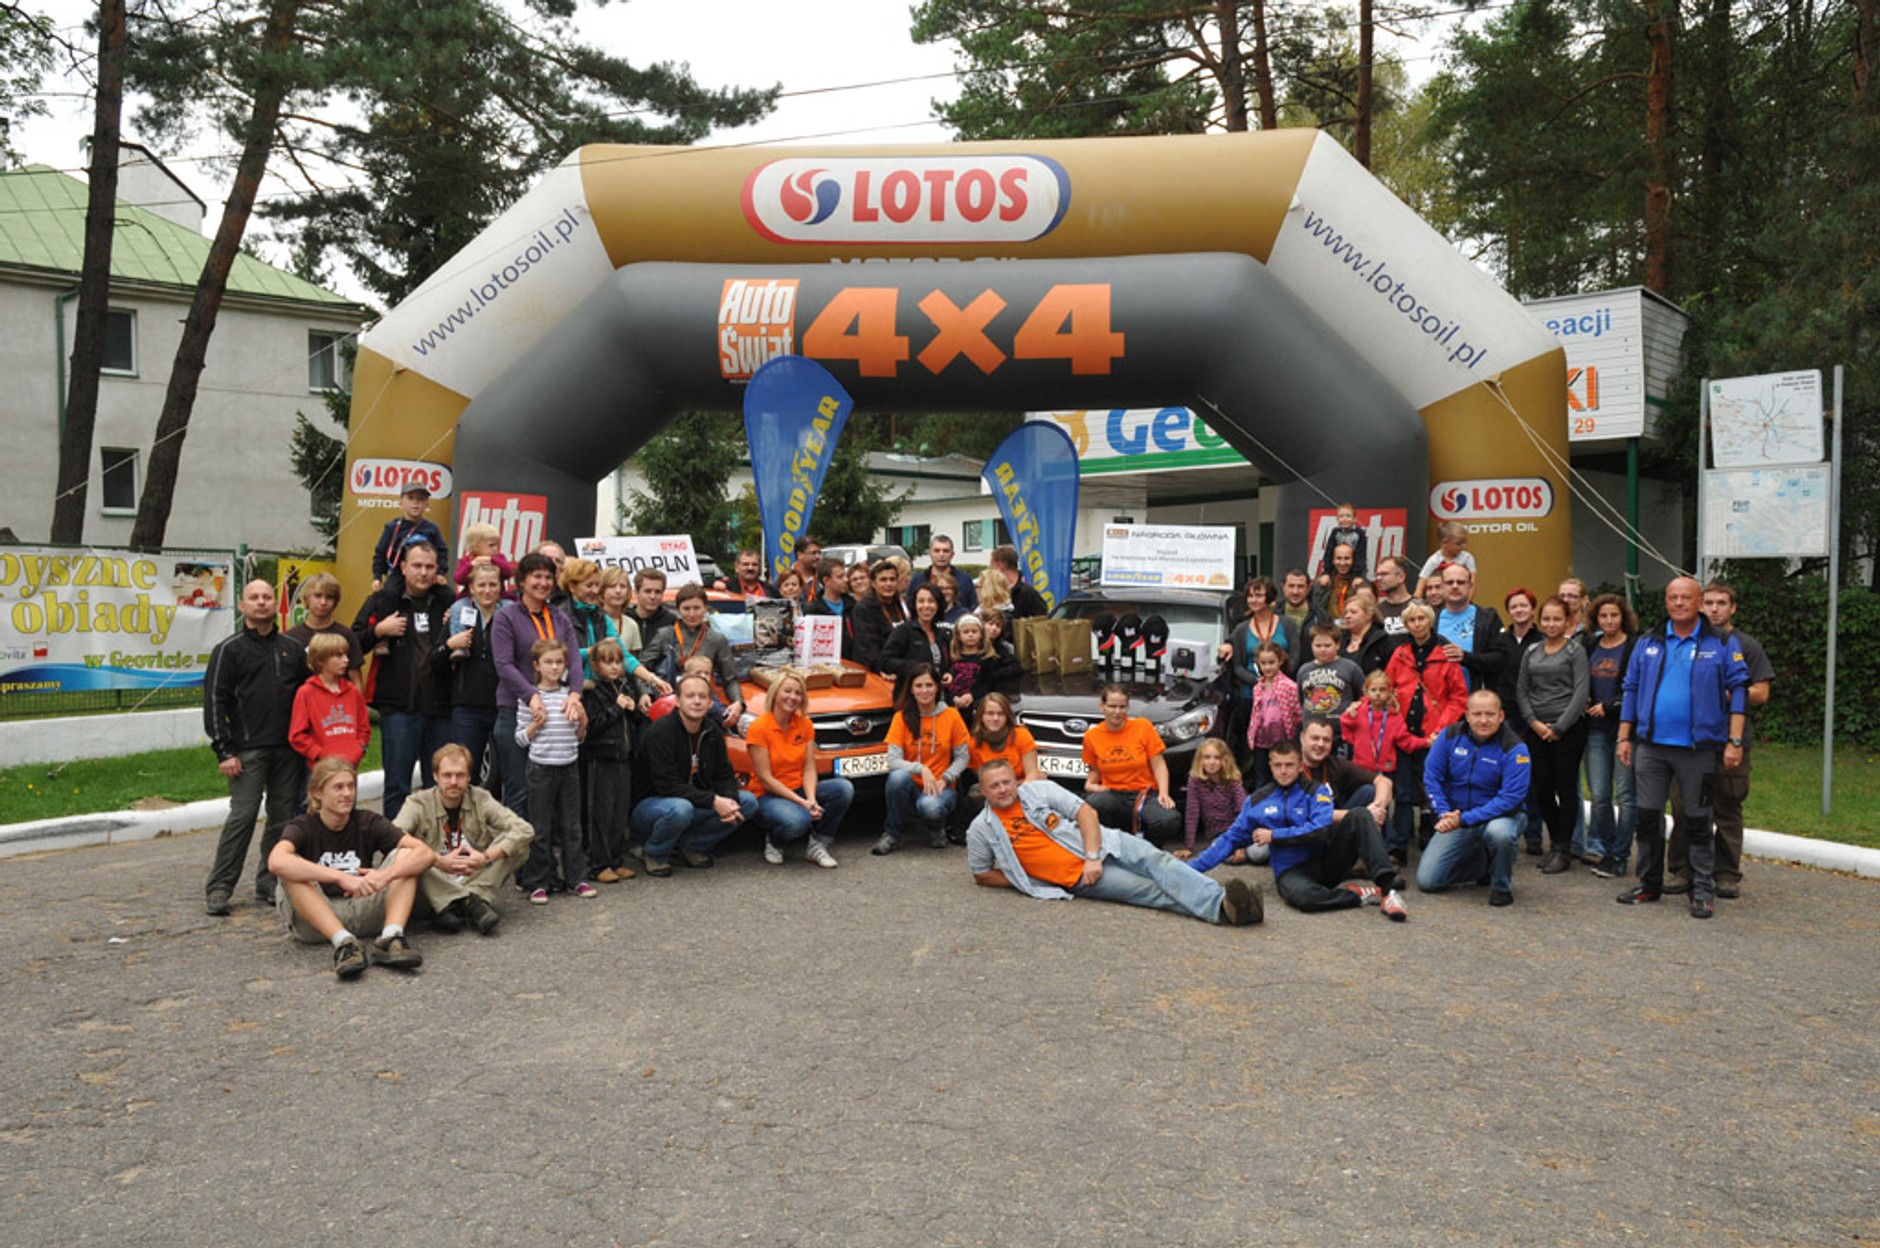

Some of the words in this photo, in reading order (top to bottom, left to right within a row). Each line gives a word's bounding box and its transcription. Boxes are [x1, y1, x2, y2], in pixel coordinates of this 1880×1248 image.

[852, 168, 1028, 223] LOTOS
[412, 208, 579, 356] www.lotosoil.pl
[1303, 211, 1488, 369] www.lotosoil.pl
[718, 280, 795, 324] Auto
[1574, 418, 1596, 434] 29
[375, 466, 442, 491] LOTOS
[774, 395, 840, 574] GOODYEAR
[1472, 486, 1544, 511] LOTOS
[1462, 523, 1512, 533] OTOR
[1516, 522, 1538, 532] OIL
[651, 554, 690, 573] PLN
[11, 590, 177, 645] obiady
[83, 653, 106, 669] w
[842, 758, 860, 773] KR
[1040, 758, 1060, 771] KR
